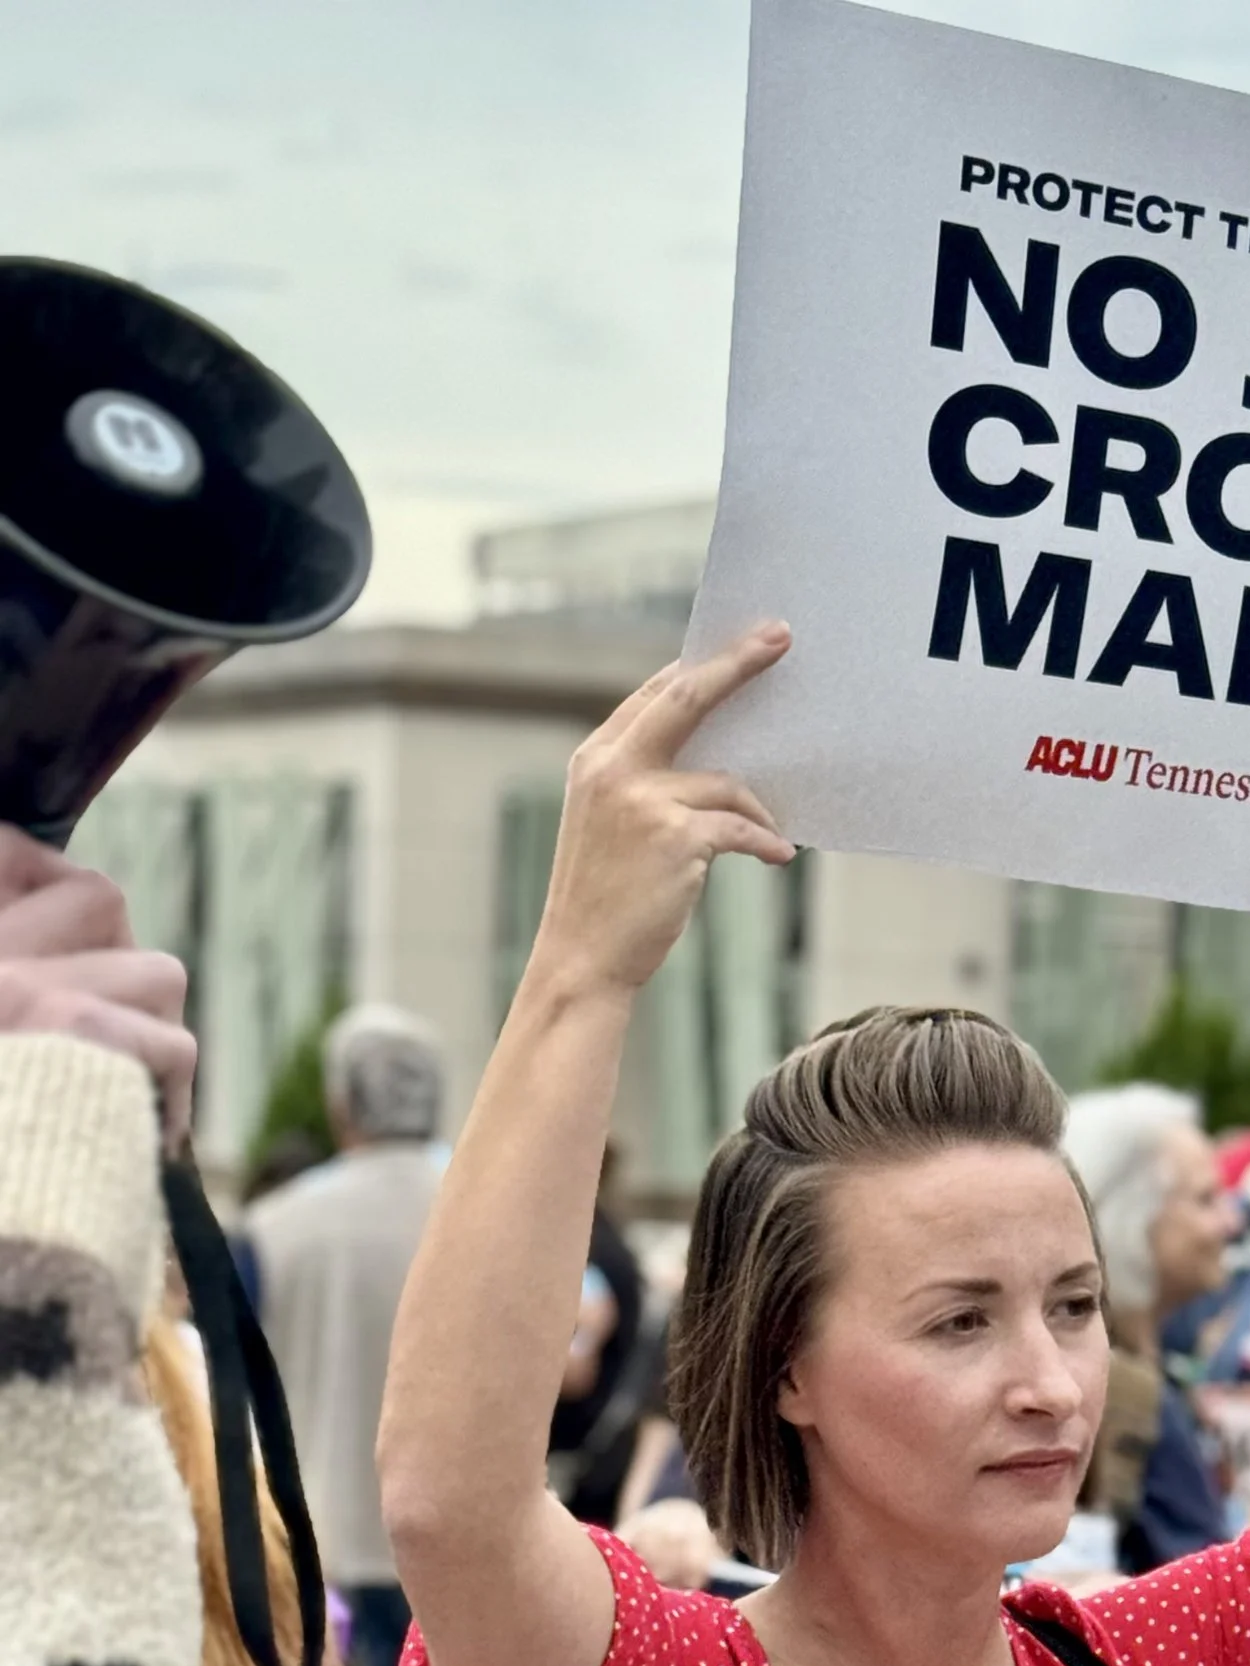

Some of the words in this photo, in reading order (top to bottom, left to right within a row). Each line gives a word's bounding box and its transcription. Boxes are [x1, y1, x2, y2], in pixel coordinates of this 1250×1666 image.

[960, 155, 1206, 240] PROTECT
[930, 220, 1198, 390] NO
[1025, 735, 1120, 783] ACLU
